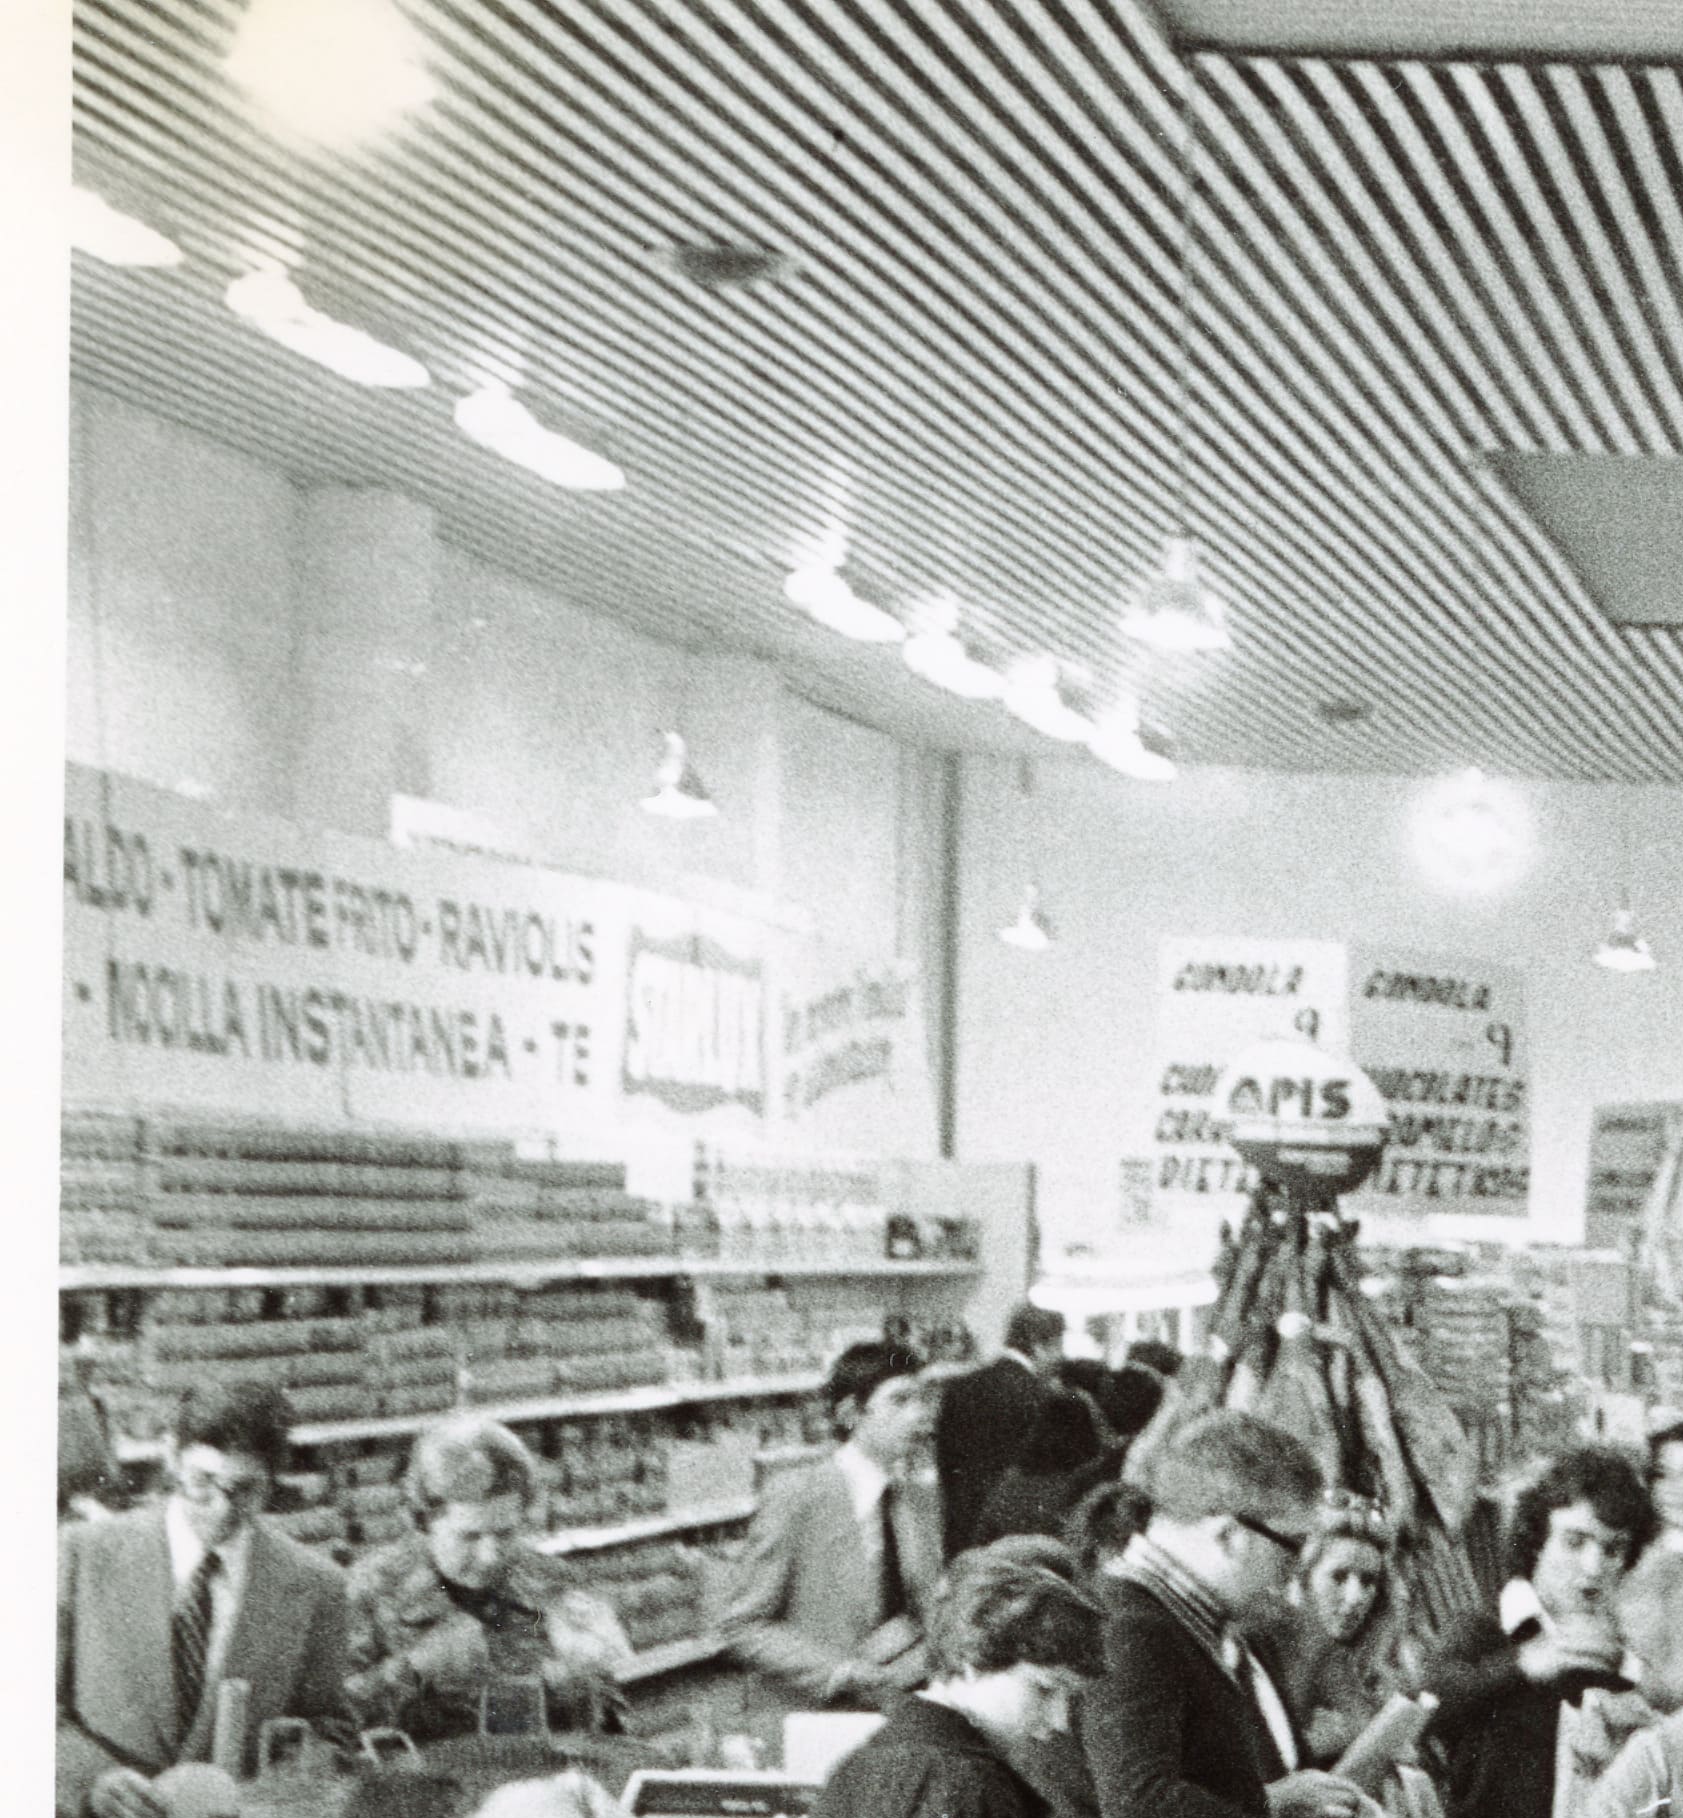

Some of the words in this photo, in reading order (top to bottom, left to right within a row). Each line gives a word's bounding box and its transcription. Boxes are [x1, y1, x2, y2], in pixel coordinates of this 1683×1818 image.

[180, 847, 329, 950] TOMATE
[333, 876, 418, 965] FRITO
[257, 983, 512, 1082] INSTANTANEA
[550, 1019, 591, 1088] TE
[1486, 1022, 1511, 1066] 9
[1227, 1075, 1353, 1119] APIS
